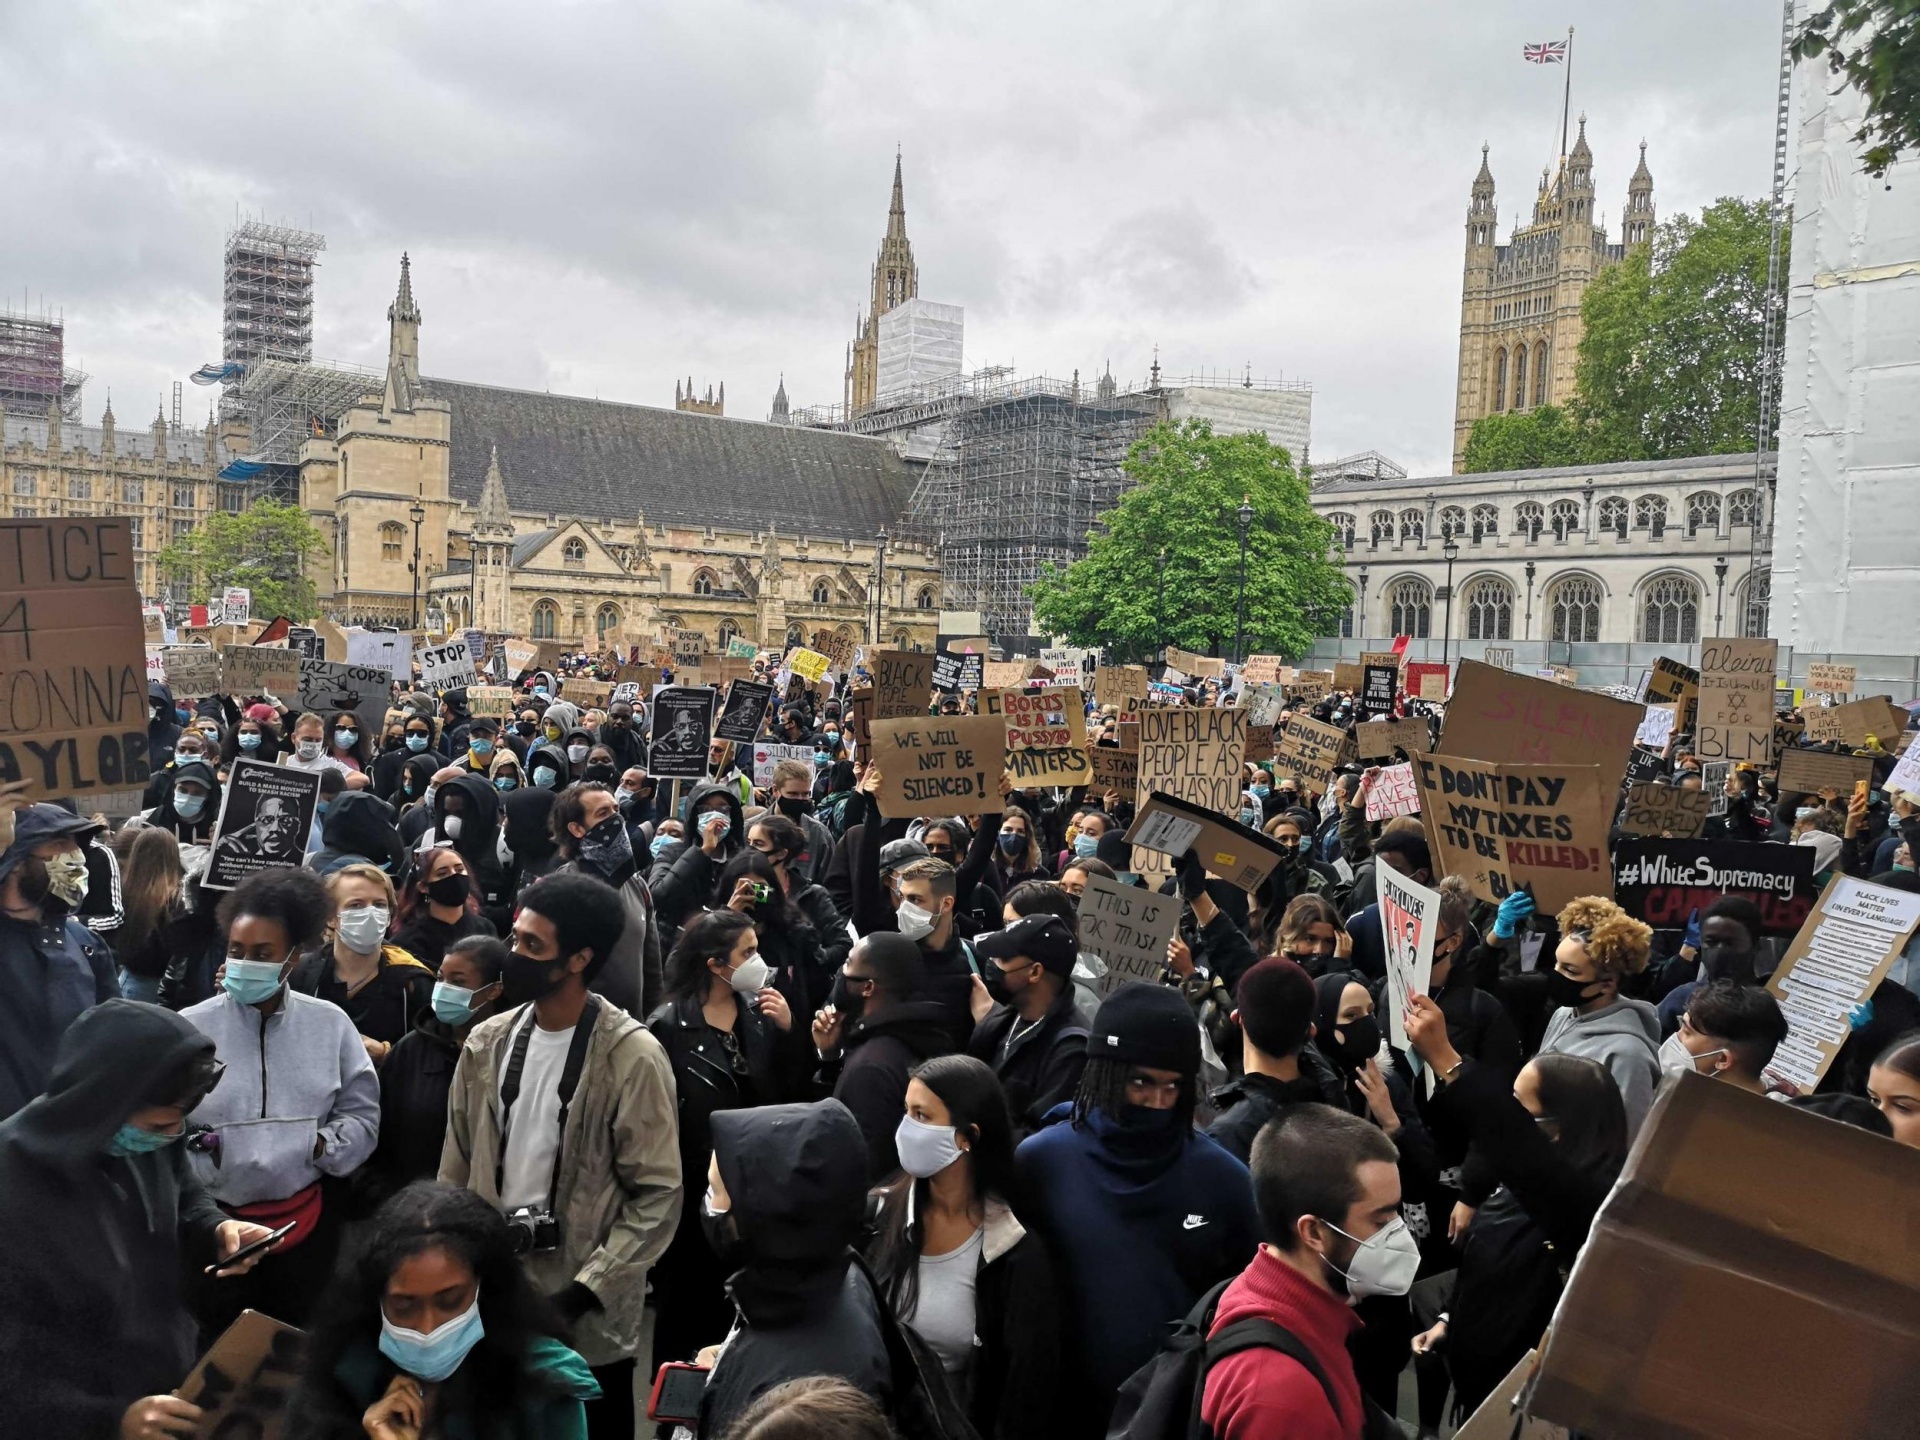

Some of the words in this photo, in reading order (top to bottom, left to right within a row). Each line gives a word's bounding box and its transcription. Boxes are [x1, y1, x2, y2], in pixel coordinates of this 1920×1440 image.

[679, 632, 703, 641] RACISM
[820, 632, 855, 650] BLACK
[425, 644, 465, 668] STOP
[683, 643, 691, 653] IS
[693, 643, 699, 653] A
[817, 643, 851, 660] LIVES
[1043, 652, 1066, 660] WHITE
[168, 650, 217, 667] ENOUGH
[948, 656, 963, 667] BLACK
[186, 668, 196, 678] IS
[229, 662, 237, 671] A
[243, 661, 296, 674] PANDEMIC
[347, 666, 386, 686] COPS
[879, 658, 925, 689] BLACK
[1106, 667, 1139, 681] BLACK
[1369, 670, 1386, 678] BORIS
[1106, 680, 1139, 691] LIVES
[1371, 677, 1390, 685] TRUMP
[1815, 681, 1844, 690] #BLM
[1832, 673, 1856, 682] BLACK
[469, 688, 486, 698] WE
[490, 688, 512, 698] NEED
[1292, 684, 1324, 694] BLACK
[1369, 683, 1390, 692] SITTING
[1378, 691, 1391, 699] TREE
[468, 698, 503, 715] CHANGE
[895, 704, 922, 716] EVERY
[1003, 692, 1064, 715] BORIS
[1016, 713, 1030, 728] IS
[1034, 713, 1047, 727] A
[1139, 710, 1181, 743] LOVE
[1184, 709, 1246, 743] BLACK
[1717, 712, 1753, 724] FOR
[893, 731, 922, 749] WE
[926, 730, 959, 747] WILL
[1286, 721, 1341, 752] ENOUGH
[1699, 726, 1769, 762] BLM
[765, 744, 800, 761] SILENCE
[1142, 744, 1210, 777] PEOPLE
[1213, 743, 1241, 777] AS
[1296, 742, 1320, 761] IS
[917, 751, 947, 771] NOT
[955, 750, 975, 770] BE
[1004, 748, 1087, 778] MATTERS
[1276, 751, 1331, 784] ENOUGH
[1638, 753, 1656, 768] UK
[238, 780, 257, 788] BUILD
[280, 785, 312, 794] MOVEMENT
[1361, 765, 1413, 794] BLACK
[1420, 760, 1437, 791] I
[1506, 775, 1567, 807] PAY
[1186, 777, 1208, 809] AS
[1209, 777, 1243, 811] YOU
[1630, 783, 1710, 813] JUSTICE
[1447, 801, 1480, 831] MY
[1480, 809, 1573, 842] TAXES
[1626, 806, 1662, 830] FOR
[1440, 824, 1470, 850] TO
[1473, 832, 1501, 862] BE
[1505, 841, 1600, 873] KILLED!
[1618, 854, 1795, 901] #WhiteSupremacy
[1093, 887, 1133, 917] THIS
[1141, 905, 1161, 923] IS
[1384, 877, 1400, 902] BLACK
[1400, 893, 1425, 920] LIVES
[1855, 890, 1879, 902] BLACK
[1880, 897, 1900, 907] LIVES
[1858, 900, 1886, 914] MATTER
[1842, 904, 1867, 918] EVERY
[1866, 912, 1907, 927] LANGUAGE)
[1187, 1213, 1203, 1224] NIKE
